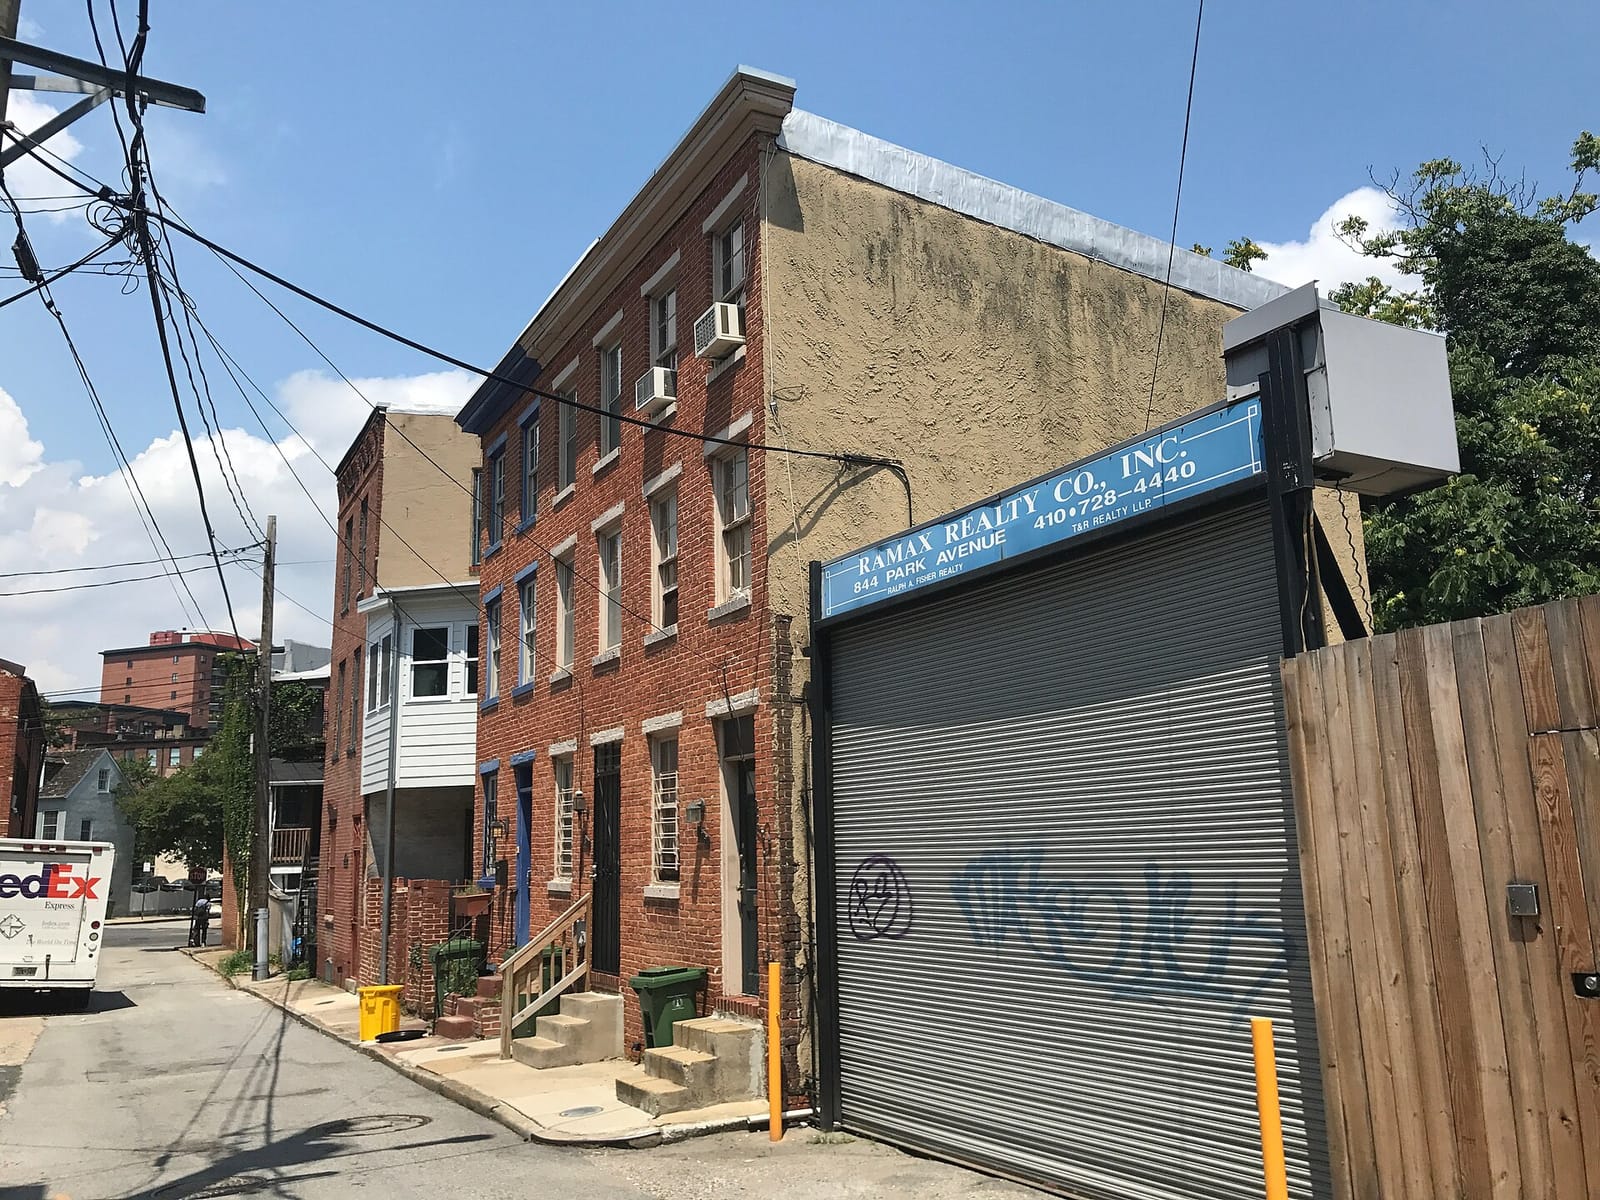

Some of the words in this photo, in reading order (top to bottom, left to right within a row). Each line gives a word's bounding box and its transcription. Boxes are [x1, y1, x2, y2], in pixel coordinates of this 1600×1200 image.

[859, 531, 933, 576] RAMAX
[944, 489, 1040, 545] REALTY
[1053, 471, 1107, 503] CO.,
[1120, 435, 1188, 479] INC.
[1072, 519, 1090, 533] T&R
[1092, 506, 1128, 527] REALTY
[853, 575, 879, 594] 844
[886, 557, 926, 583] PARK
[936, 528, 1006, 565] AVENUE
[887, 582, 907, 595] RALPH
[915, 572, 937, 585] FISHER
[938, 563, 964, 577] REALTY
[44, 901, 75, 911] Express
